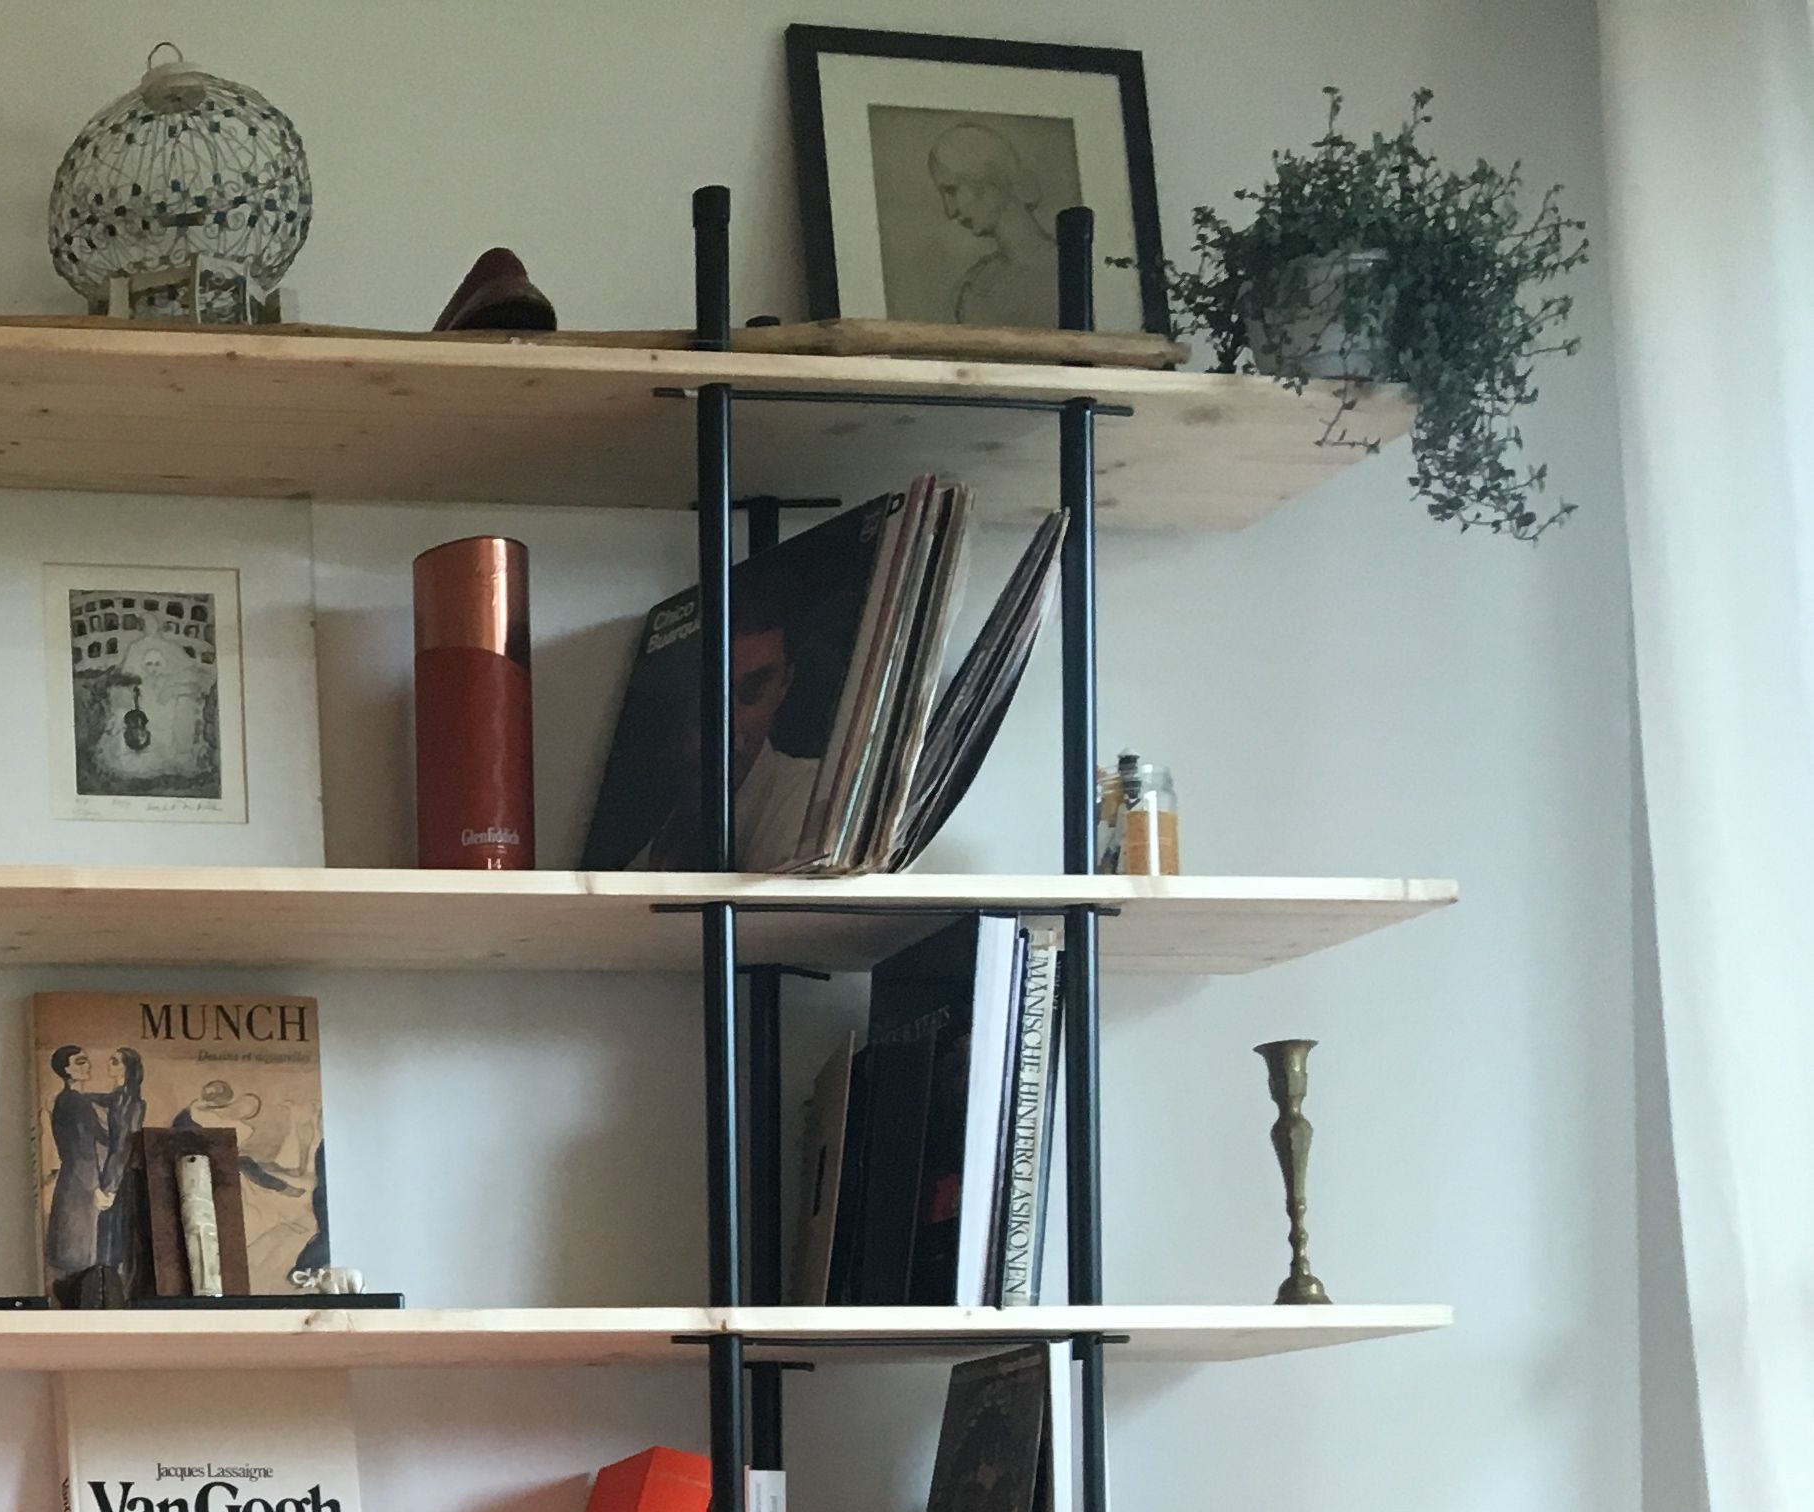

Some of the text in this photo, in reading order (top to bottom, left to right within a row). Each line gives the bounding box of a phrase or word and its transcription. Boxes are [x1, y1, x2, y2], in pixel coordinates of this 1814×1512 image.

[652, 600, 696, 632] Chico
[487, 857, 503, 870] 14
[140, 1002, 312, 1042] MUNCH
[197, 1049, 239, 1063] Dessins
[241, 1050, 253, 1062] et
[156, 1462, 274, 1483] Jacques Lassaigne
